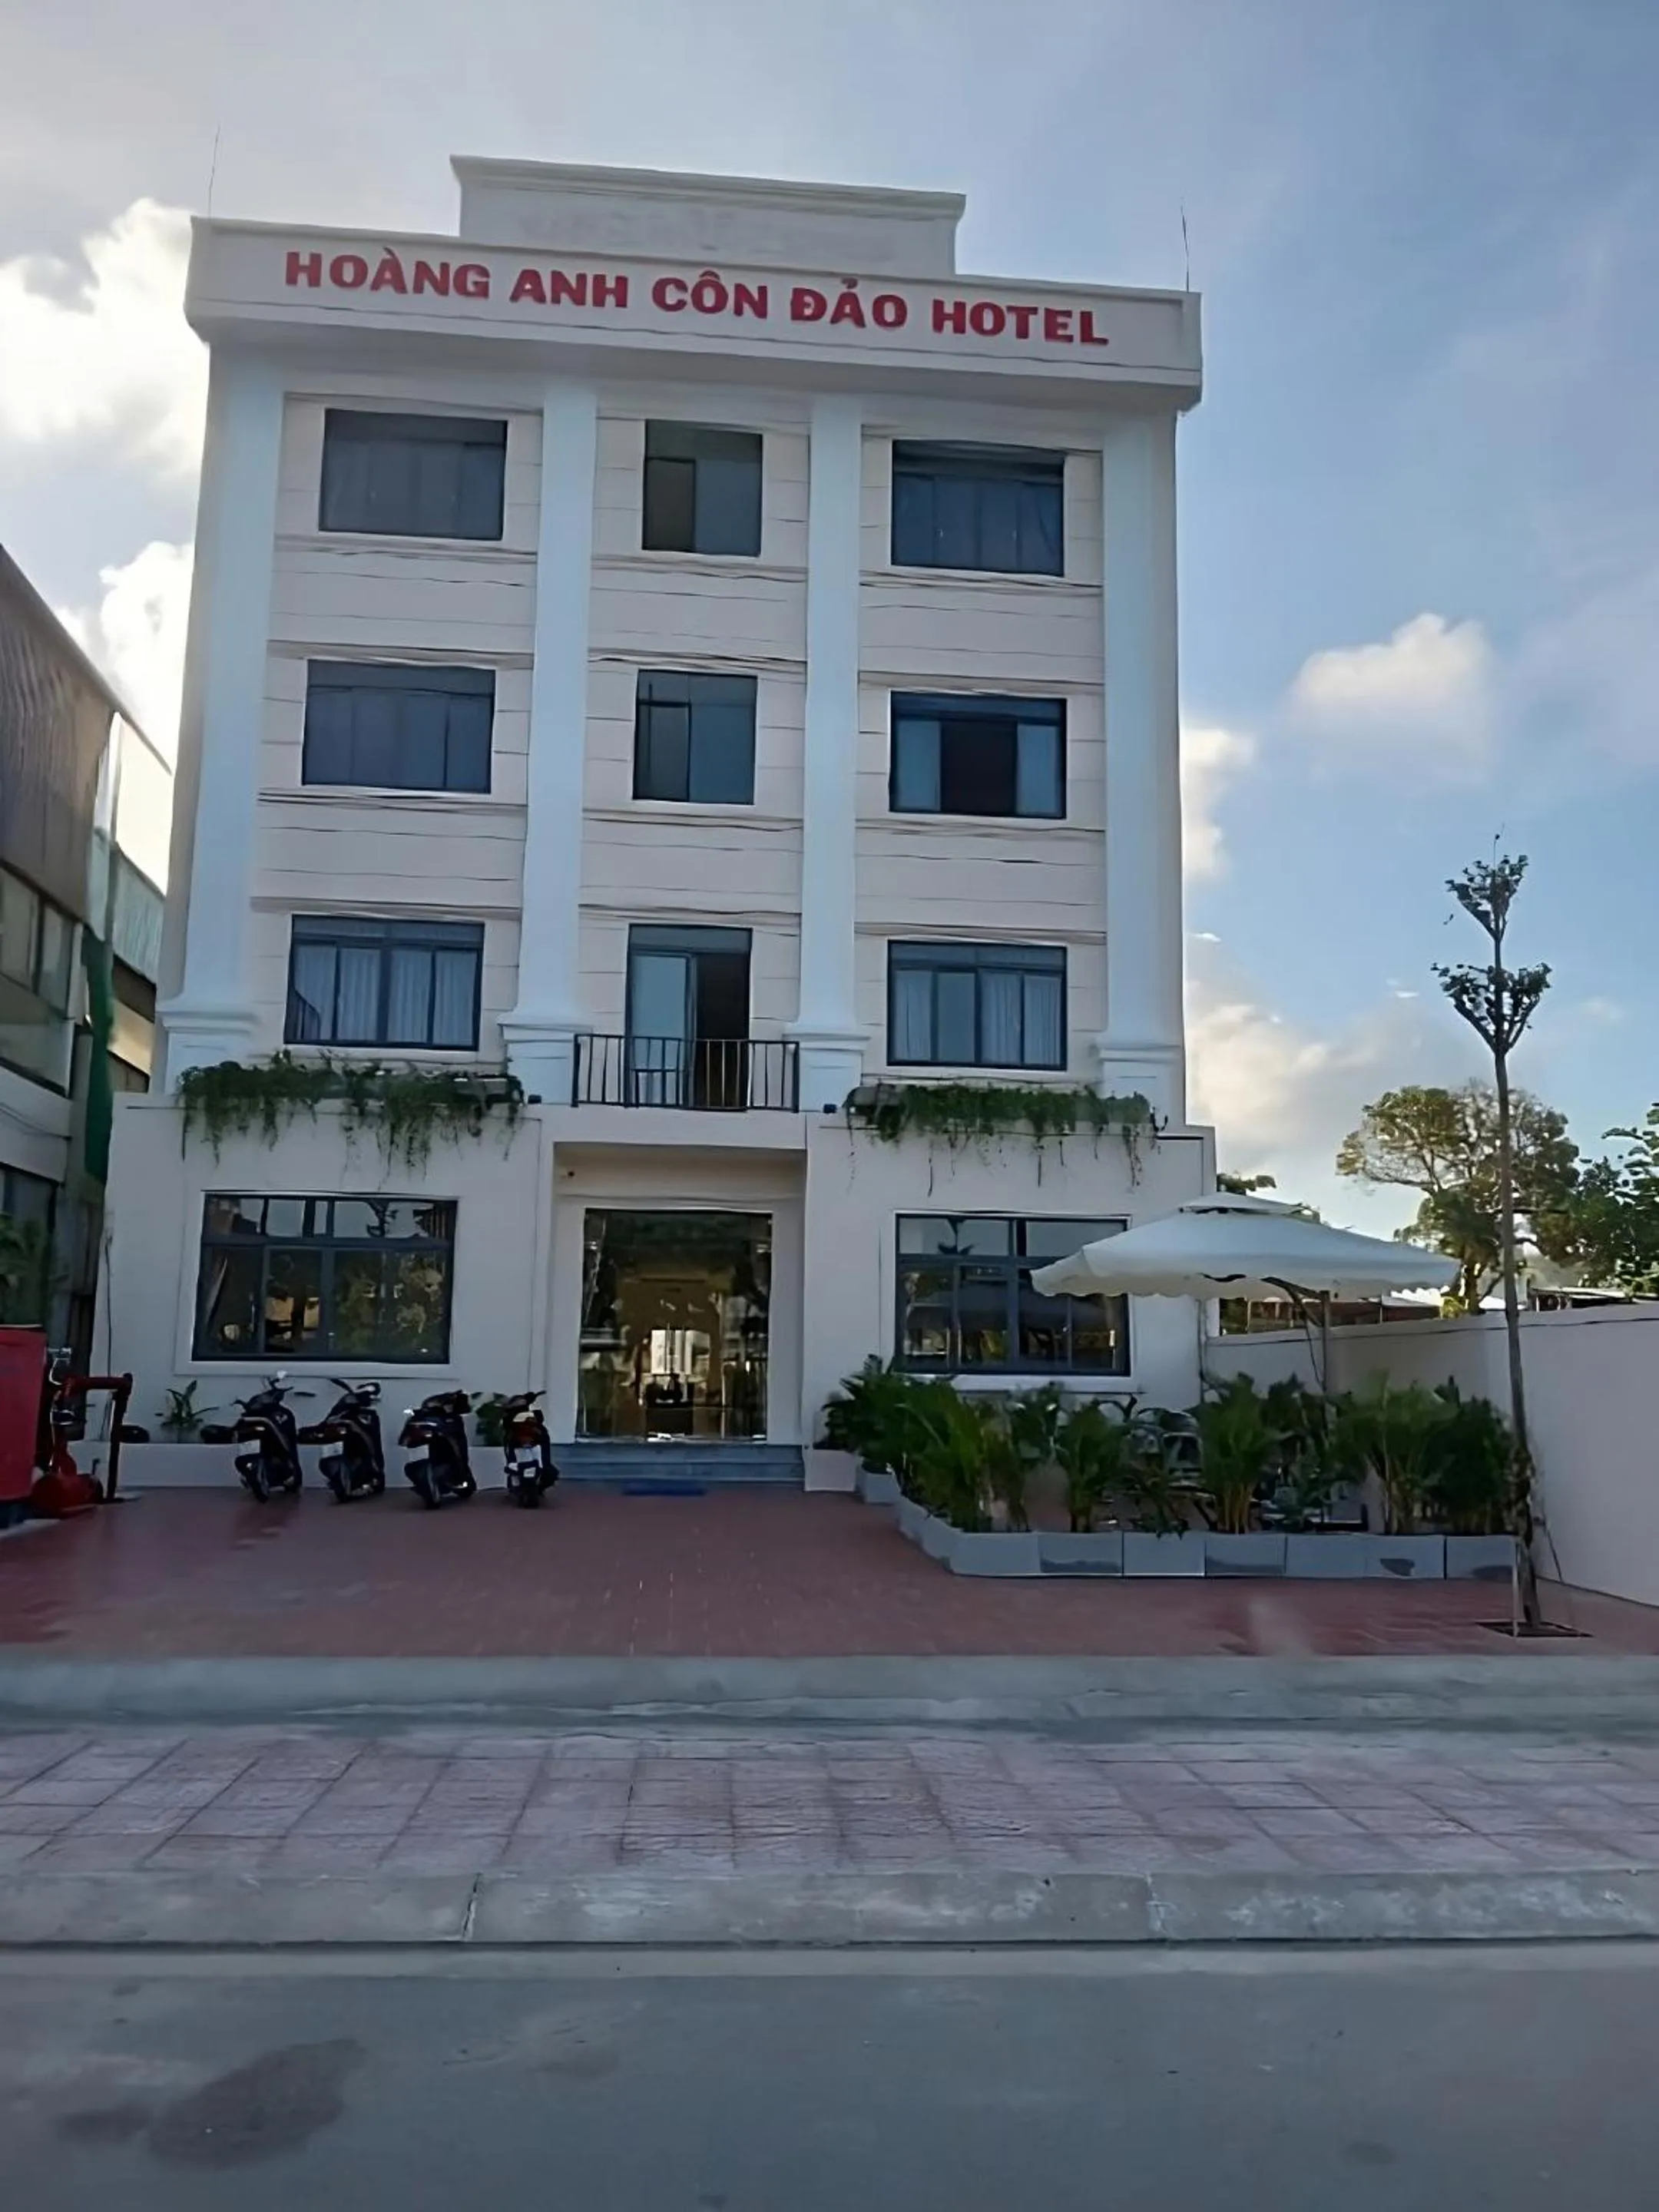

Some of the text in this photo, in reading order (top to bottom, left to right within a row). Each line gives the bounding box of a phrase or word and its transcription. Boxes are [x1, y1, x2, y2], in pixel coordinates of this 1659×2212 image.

[285, 247, 1109, 346] HOÀNG ANH CÔN ĐẢO HOTEL
